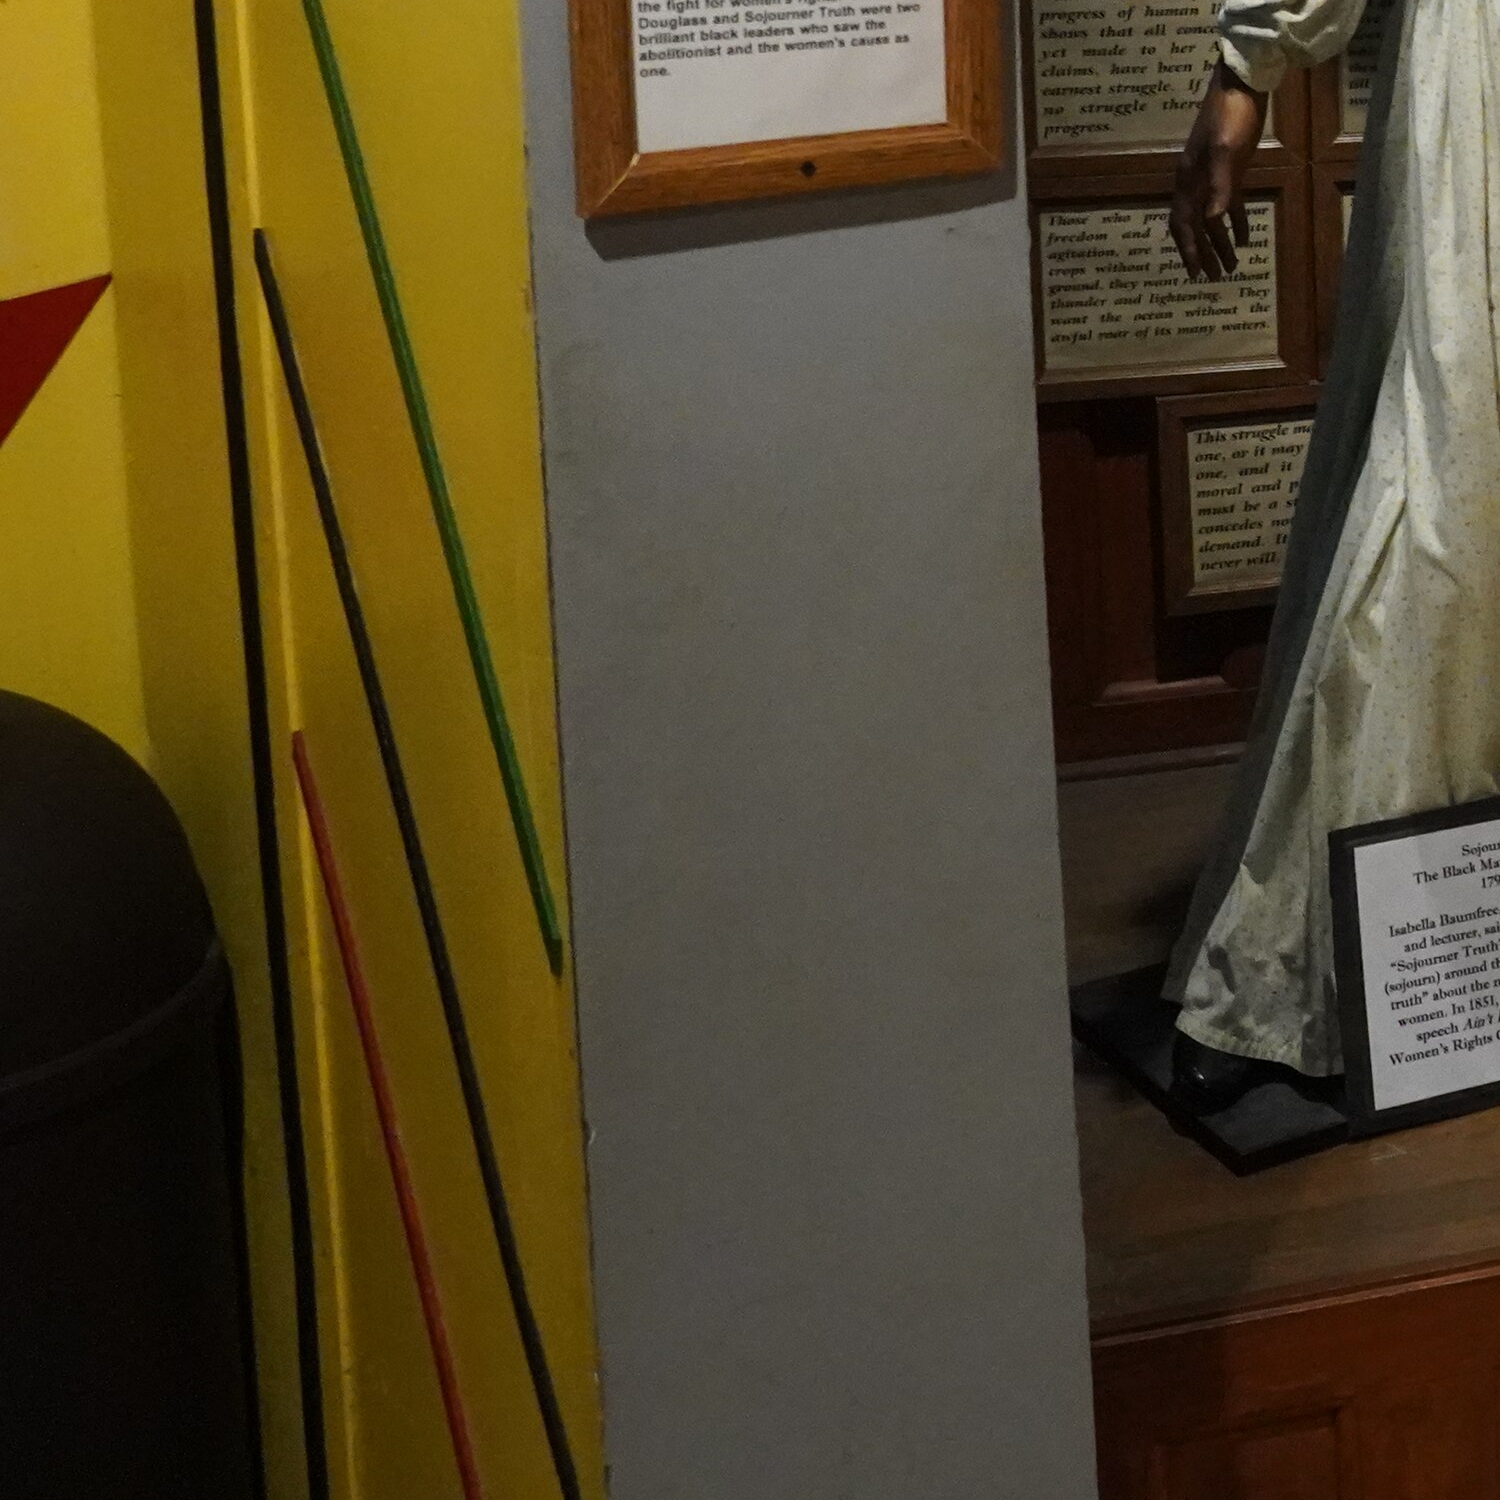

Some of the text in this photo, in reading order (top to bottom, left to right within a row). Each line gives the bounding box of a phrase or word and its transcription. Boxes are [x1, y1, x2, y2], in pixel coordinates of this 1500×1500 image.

[637, 3, 921, 31] Douglass and Sojourner Truth were two
[1412, 870, 1440, 886] The
[1442, 861, 1477, 879] Black
[1403, 936, 1428, 953] and
[1450, 1002, 1466, 1016] In
[1451, 1034, 1494, 1053] Rights
